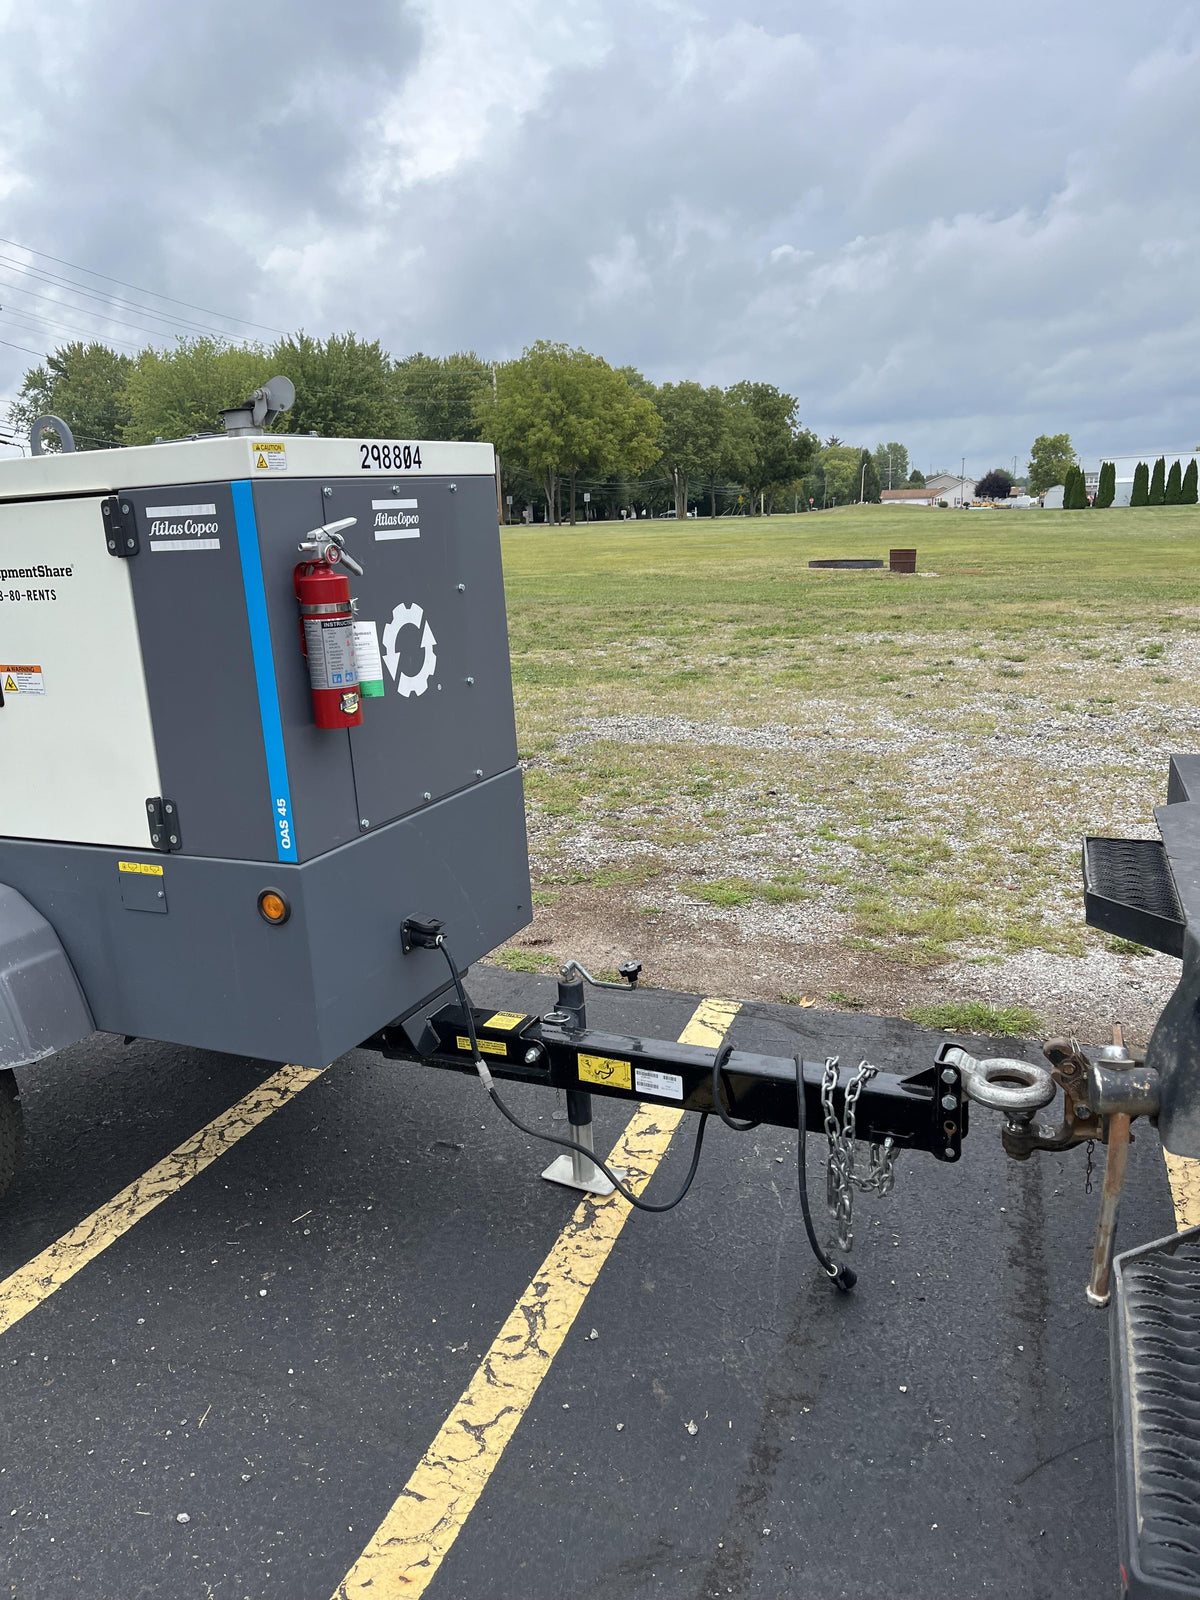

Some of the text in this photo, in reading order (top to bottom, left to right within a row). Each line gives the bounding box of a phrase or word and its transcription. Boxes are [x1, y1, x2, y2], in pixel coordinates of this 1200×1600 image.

[360, 444, 422, 469] 298804
[373, 511, 419, 527] Atlas Copco
[148, 519, 219, 537] Atlas Copco
[277, 799, 286, 816] 45
